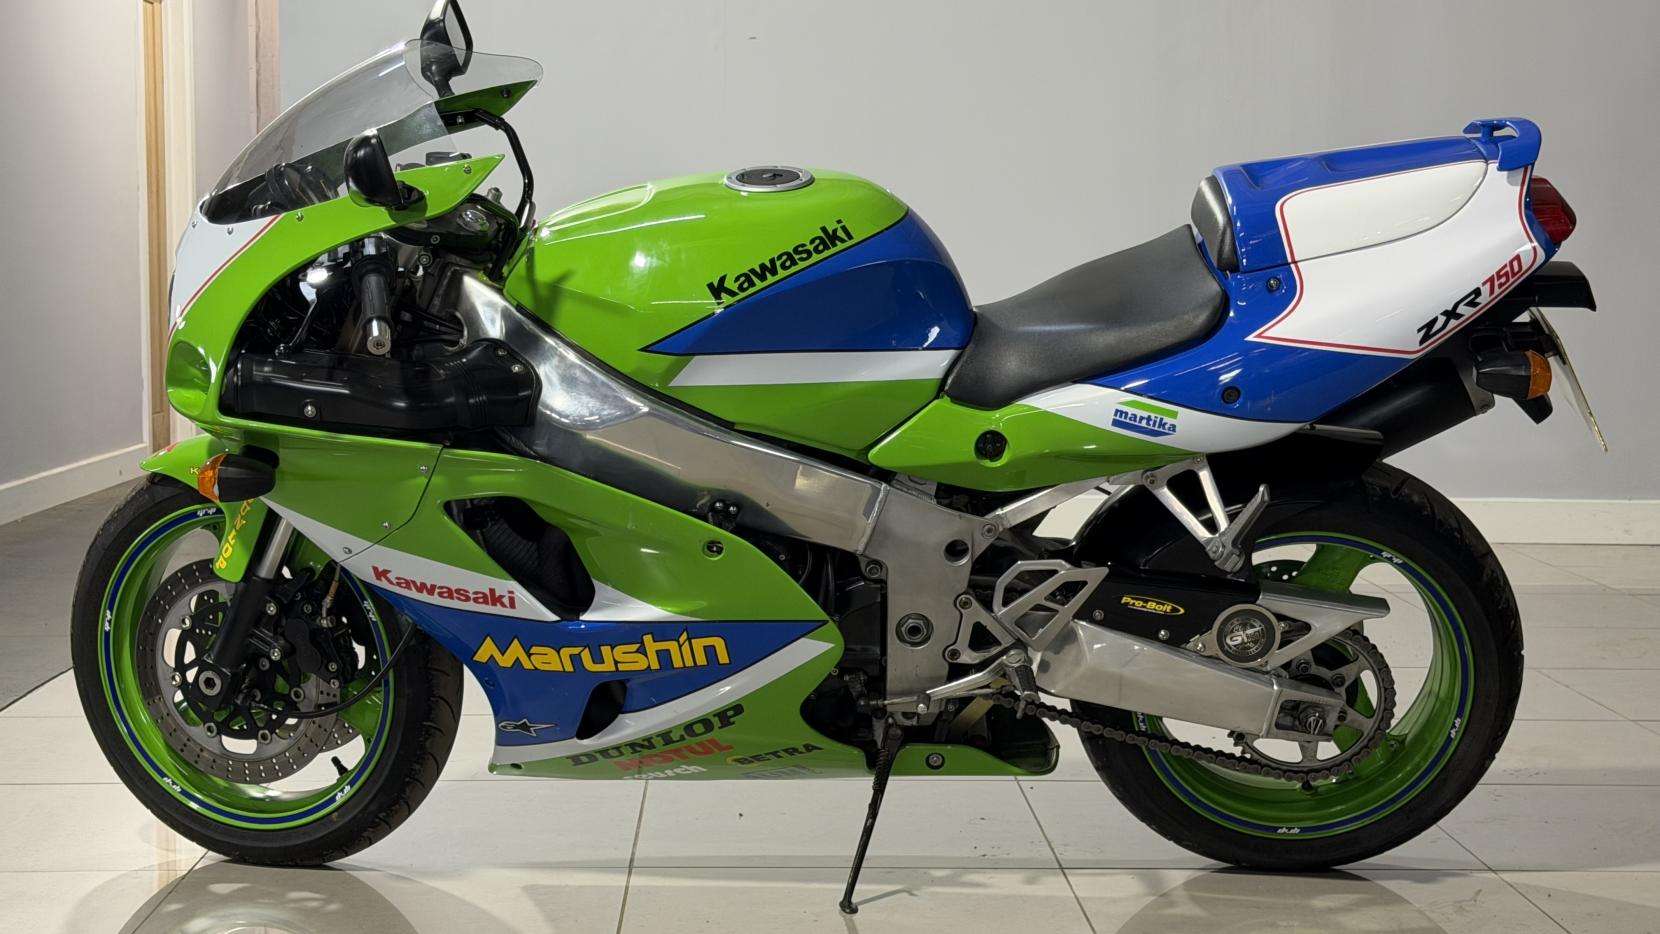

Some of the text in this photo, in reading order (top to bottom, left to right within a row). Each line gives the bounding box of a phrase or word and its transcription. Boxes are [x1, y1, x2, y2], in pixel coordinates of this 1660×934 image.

[706, 219, 854, 305] Kawasaki
[1417, 253, 1523, 346] ZXR 750
[1113, 407, 1177, 433] martika
[371, 565, 517, 610] Kawasaki
[1121, 596, 1173, 613] Pro-Bolt
[472, 627, 730, 673] Marushin
[566, 703, 745, 766] DUNLOP
[611, 737, 734, 772] MOTUL
